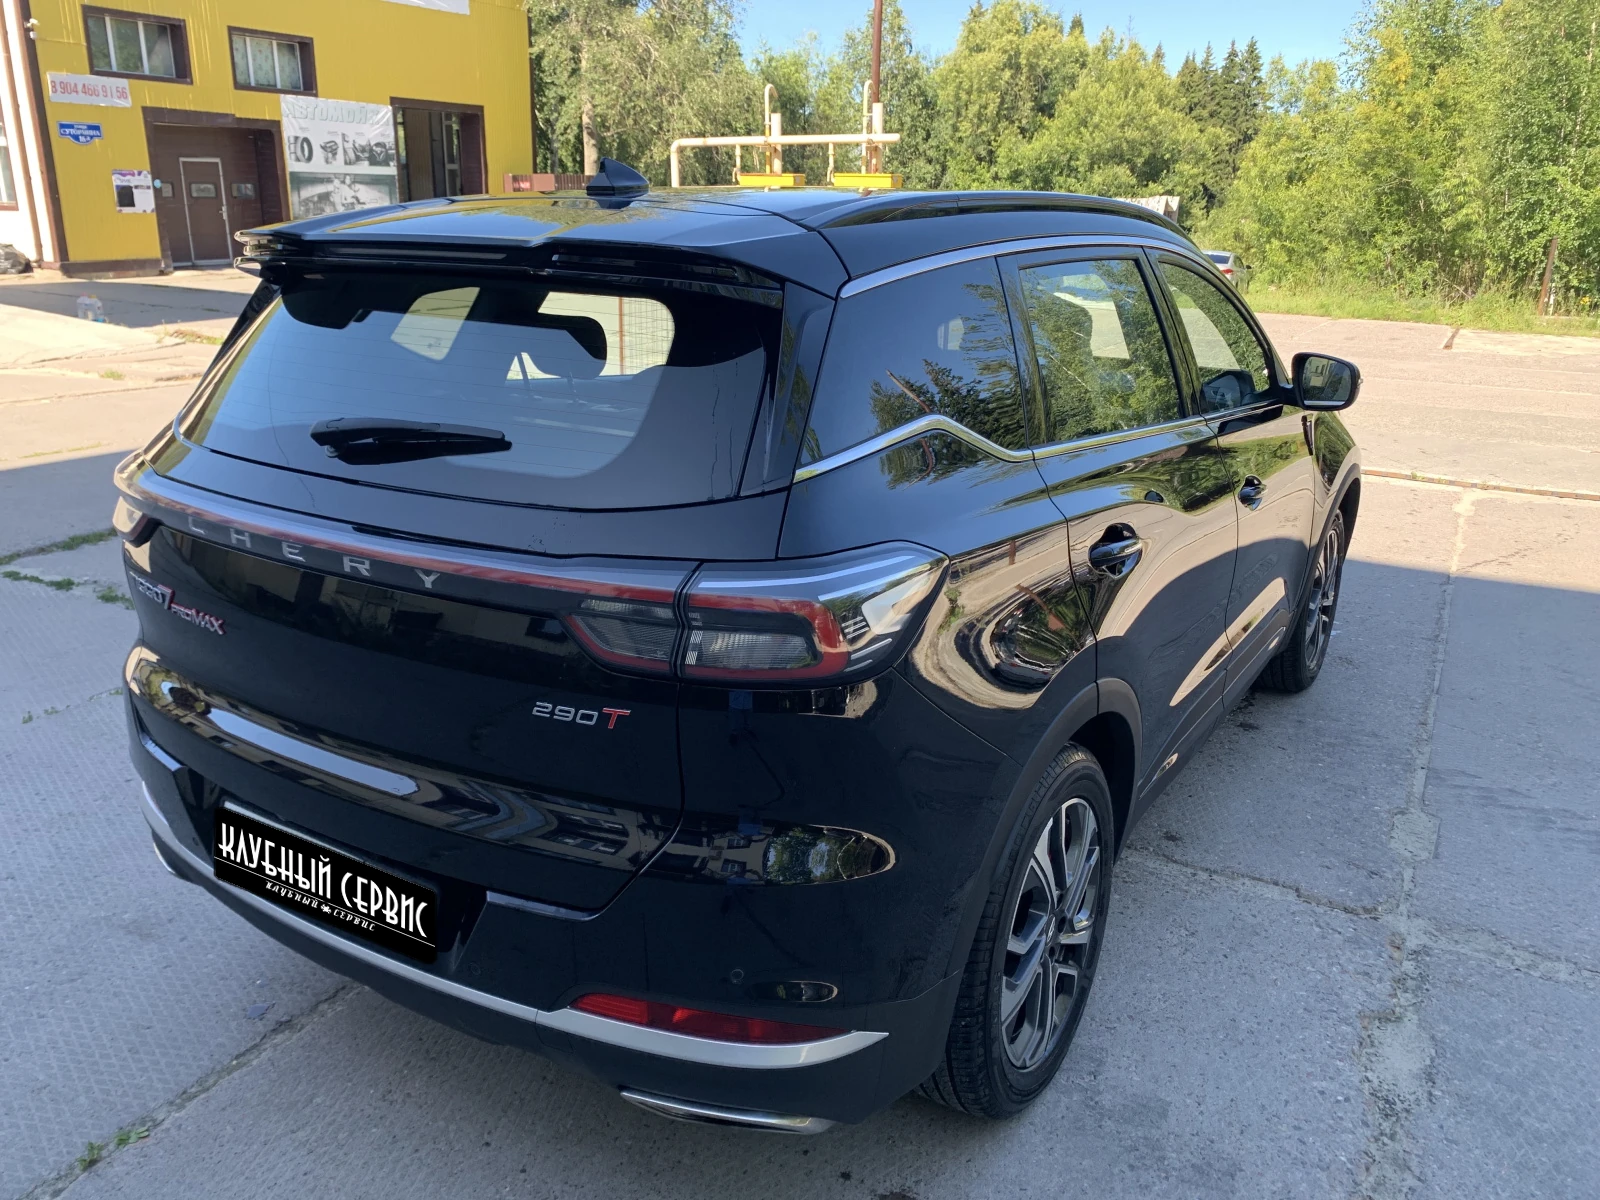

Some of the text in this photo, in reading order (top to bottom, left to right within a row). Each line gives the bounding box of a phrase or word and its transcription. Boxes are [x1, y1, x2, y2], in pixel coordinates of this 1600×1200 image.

[51, 80, 58, 94] 8
[59, 81, 79, 96] 904
[115, 86, 128, 100] 56
[187, 516, 441, 589] CHERY
[531, 701, 632, 730] 290T
